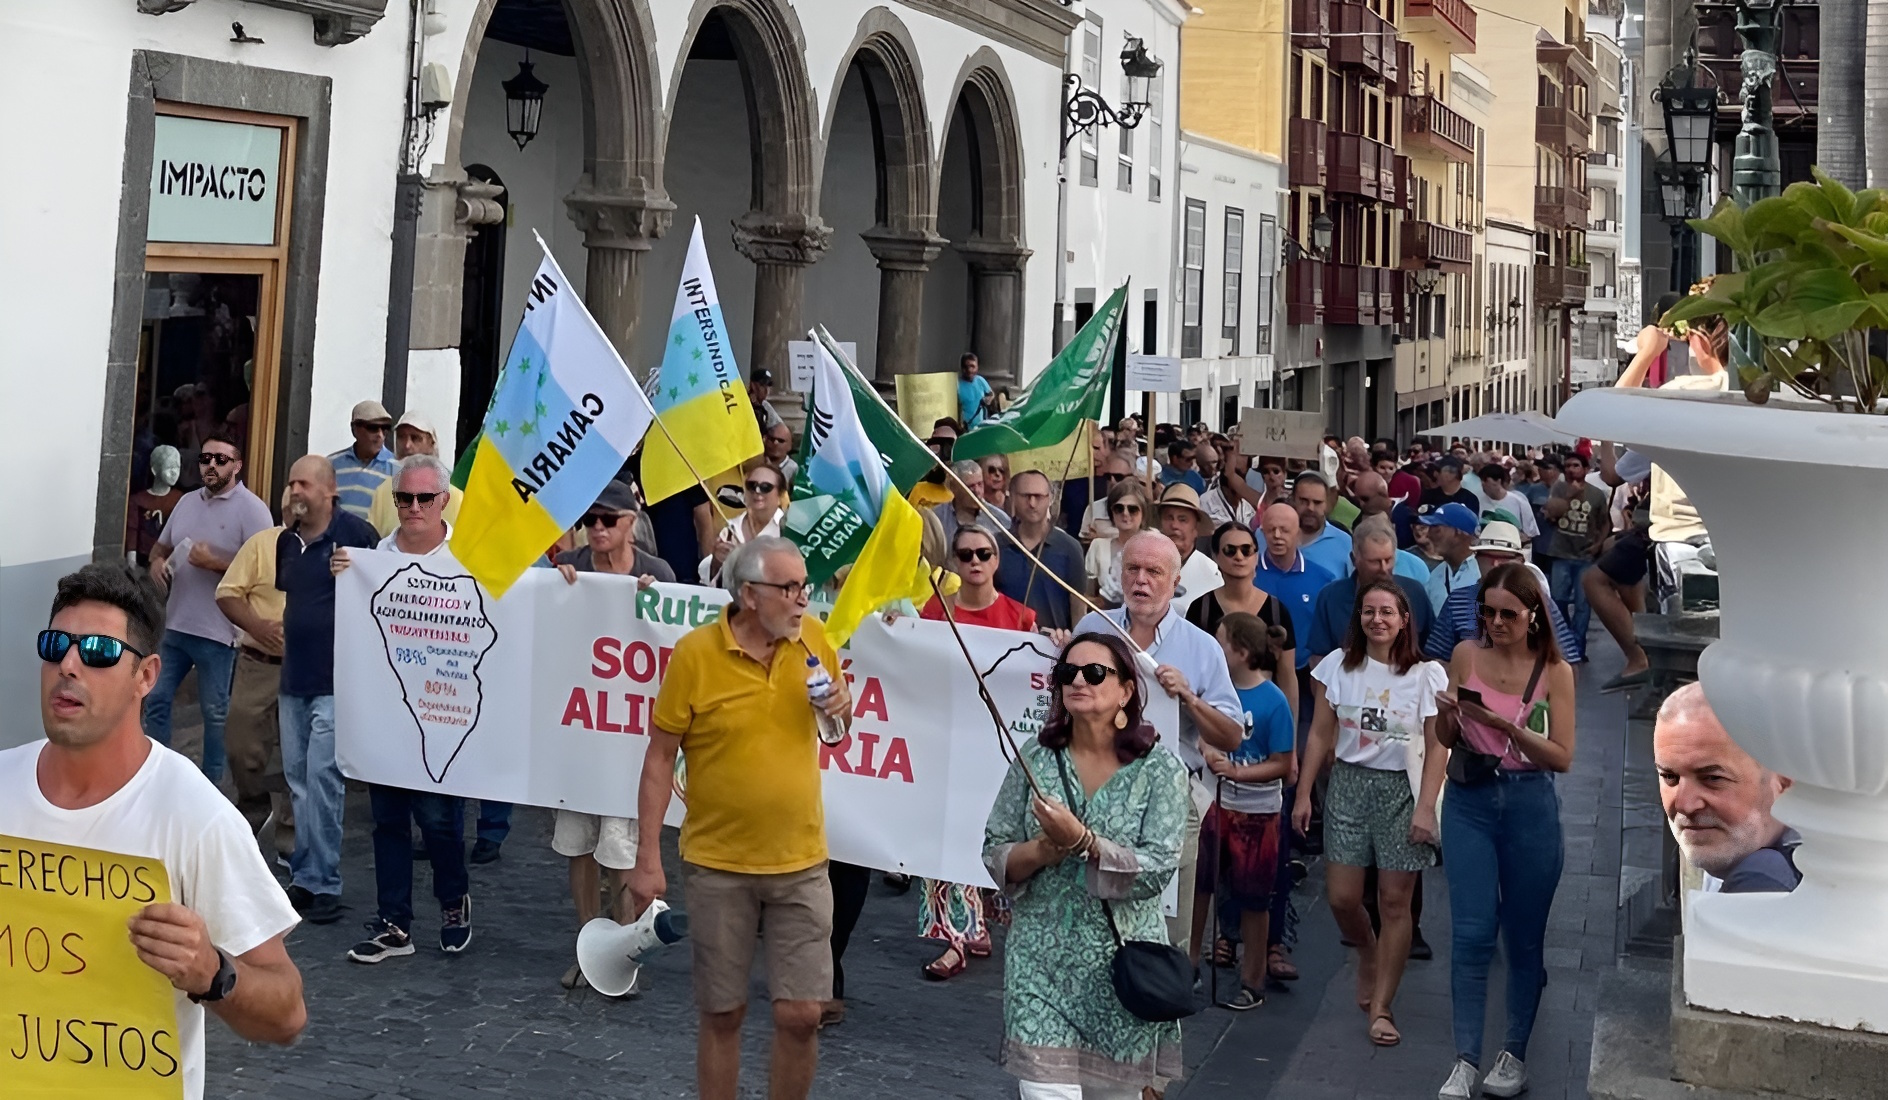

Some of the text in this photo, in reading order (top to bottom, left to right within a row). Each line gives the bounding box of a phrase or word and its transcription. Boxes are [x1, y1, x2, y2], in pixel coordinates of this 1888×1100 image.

[160, 159, 265, 202] IMPACTO
[682, 277, 740, 415] INTERSINDICAL
[10, 1013, 178, 1078] JUSTOS
